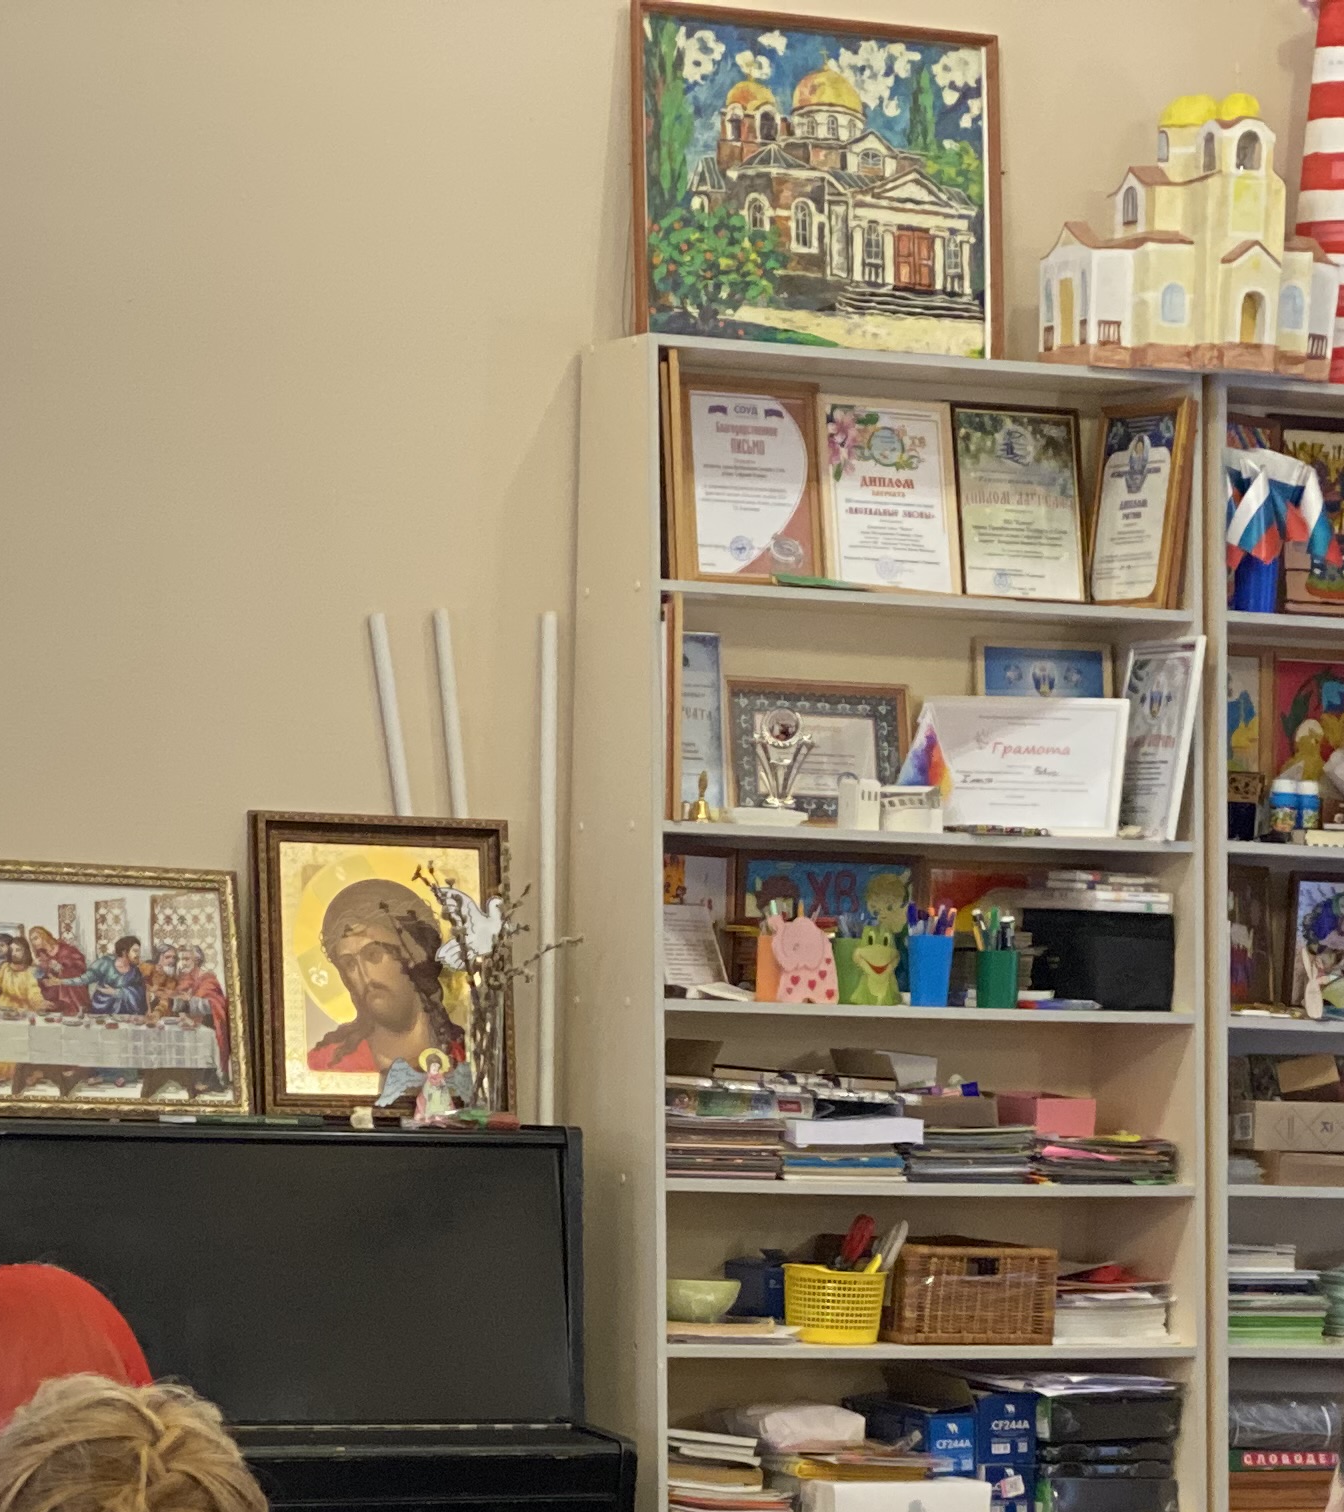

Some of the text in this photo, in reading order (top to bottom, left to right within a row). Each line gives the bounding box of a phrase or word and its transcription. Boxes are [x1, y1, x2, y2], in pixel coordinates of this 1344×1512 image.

[860, 475, 915, 489] ДИПЛОМ
[991, 742, 1071, 758] Грамота
[991, 1420, 1030, 1430] CF244A
[936, 1440, 972, 1450] CF244A
